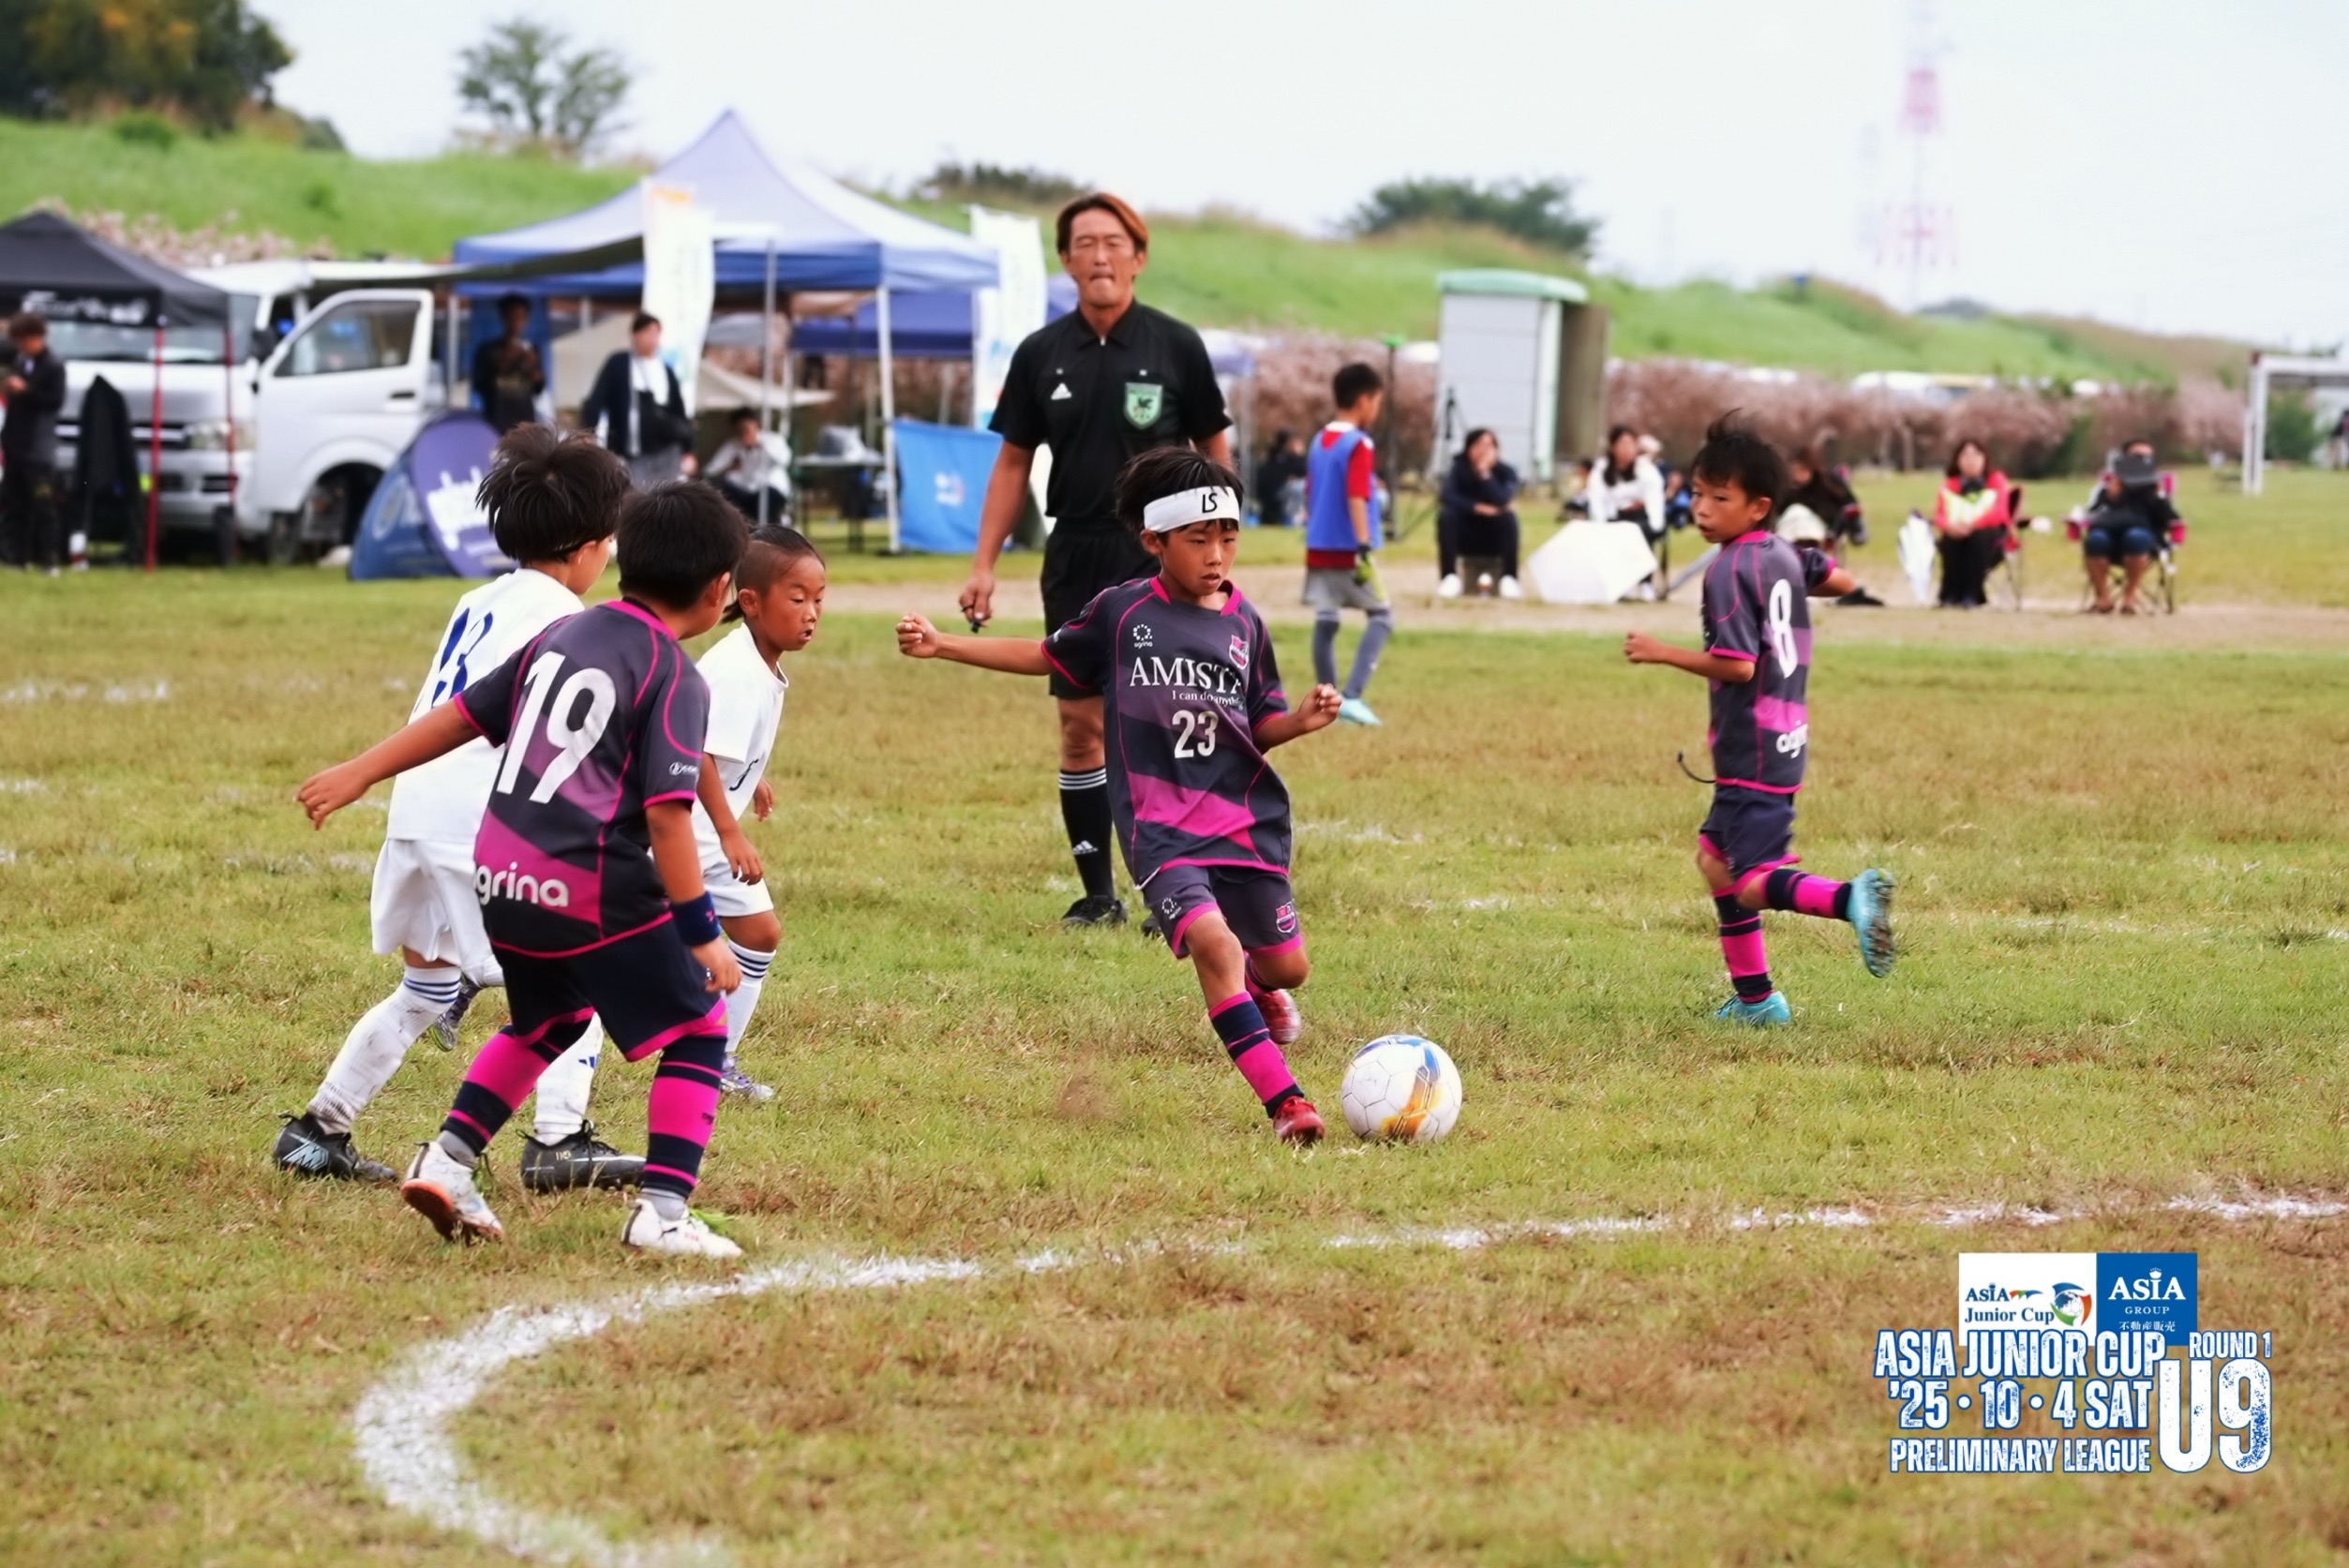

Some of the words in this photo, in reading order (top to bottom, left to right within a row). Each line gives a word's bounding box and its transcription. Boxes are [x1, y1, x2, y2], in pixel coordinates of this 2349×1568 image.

[1769, 578, 1798, 679] 8
[1179, 692, 1198, 701] can
[497, 650, 617, 804] 19
[1172, 709, 1219, 758] 23
[472, 861, 570, 908] grina
